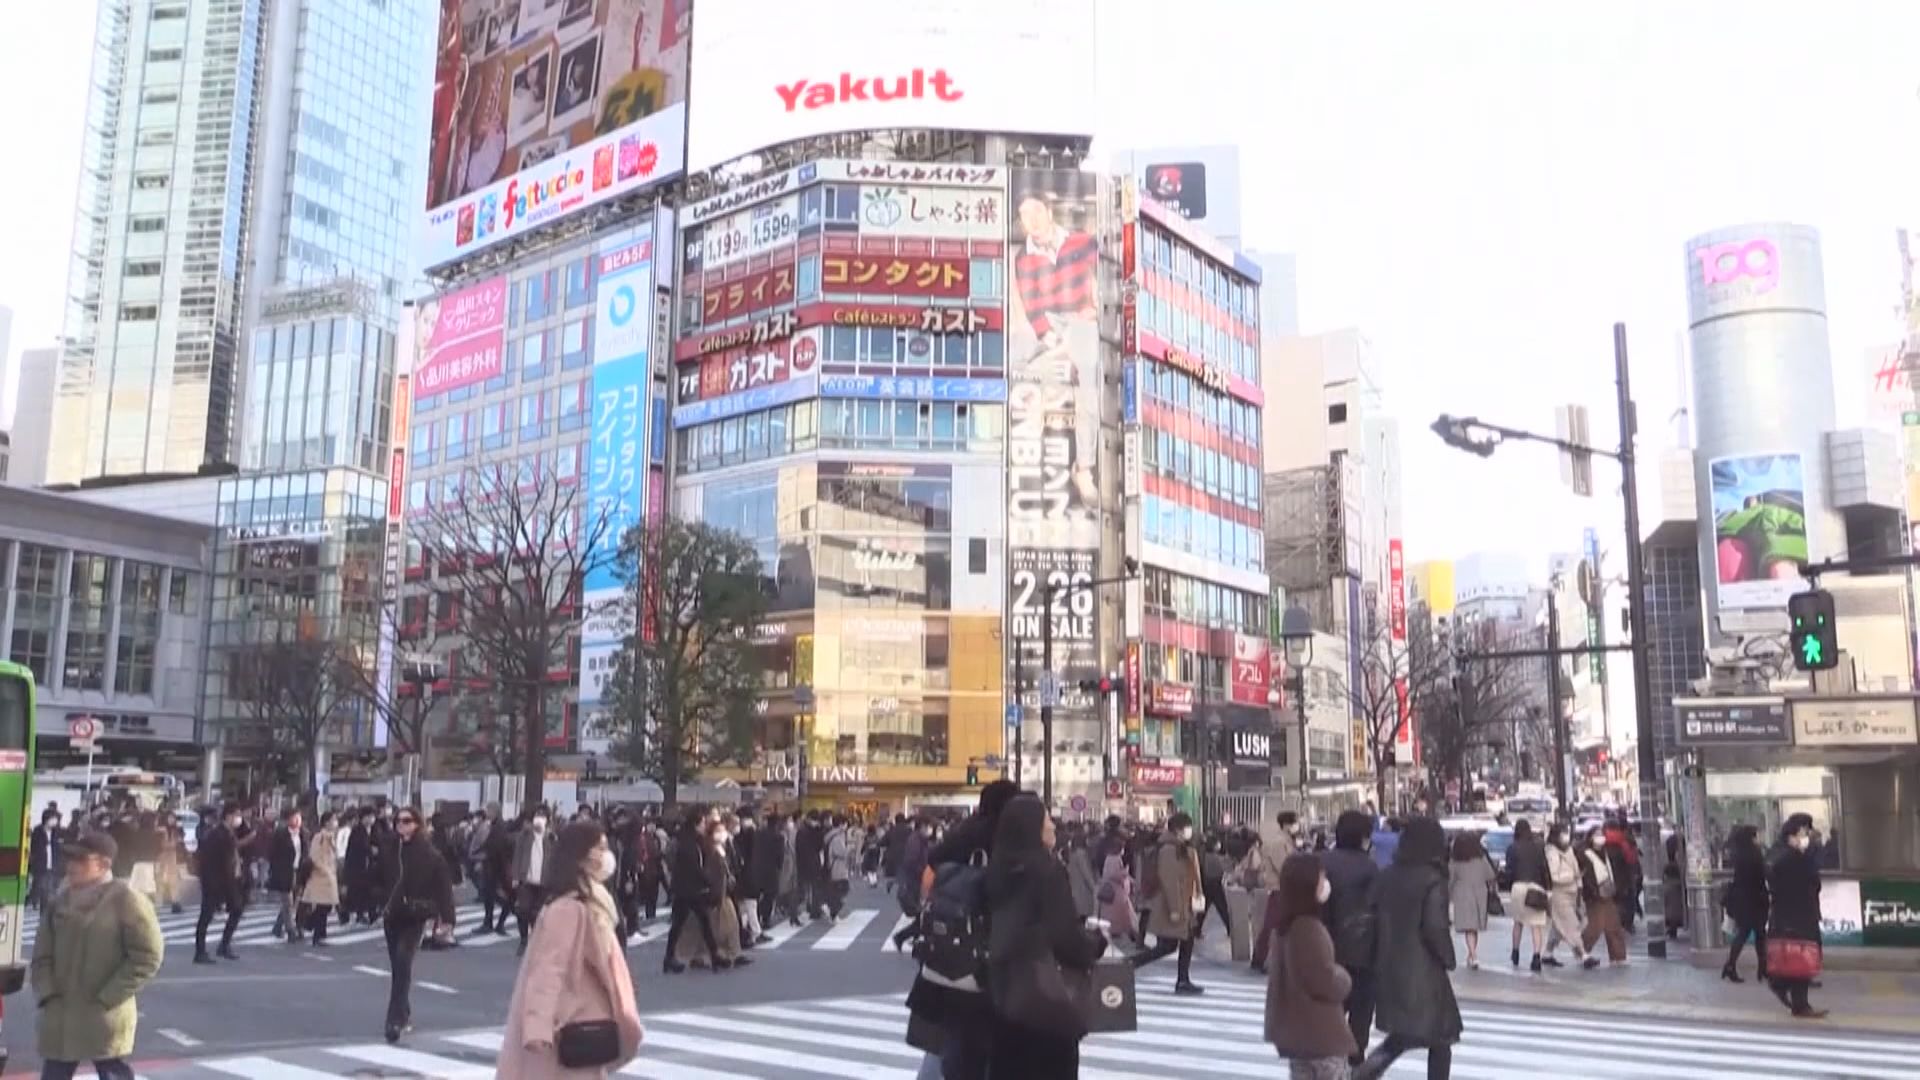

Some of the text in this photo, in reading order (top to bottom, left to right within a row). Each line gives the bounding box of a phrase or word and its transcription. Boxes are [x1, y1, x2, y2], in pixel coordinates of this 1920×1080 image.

[775, 68, 964, 112] Yakult
[846, 162, 996, 182] しゃぶしゃぶバイキング
[910, 196, 998, 225] しゃぶ葉
[823, 258, 965, 289] コンタクト
[1695, 238, 1781, 297] 109
[752, 311, 799, 344] ガスト
[920, 308, 987, 334] ガスト
[729, 350, 785, 391] ガスト
[680, 374, 699, 396] 7F
[879, 378, 1003, 397] 英会話イーオン
[226, 519, 334, 541] MARK CITY
[1012, 571, 1094, 616] 2.26
[1012, 616, 1093, 640] ON SALE
[1238, 663, 1263, 684] アコム
[1804, 719, 1869, 736] しぶちか
[1234, 732, 1270, 758] LUSH
[766, 765, 869, 782] L'OCITANE
